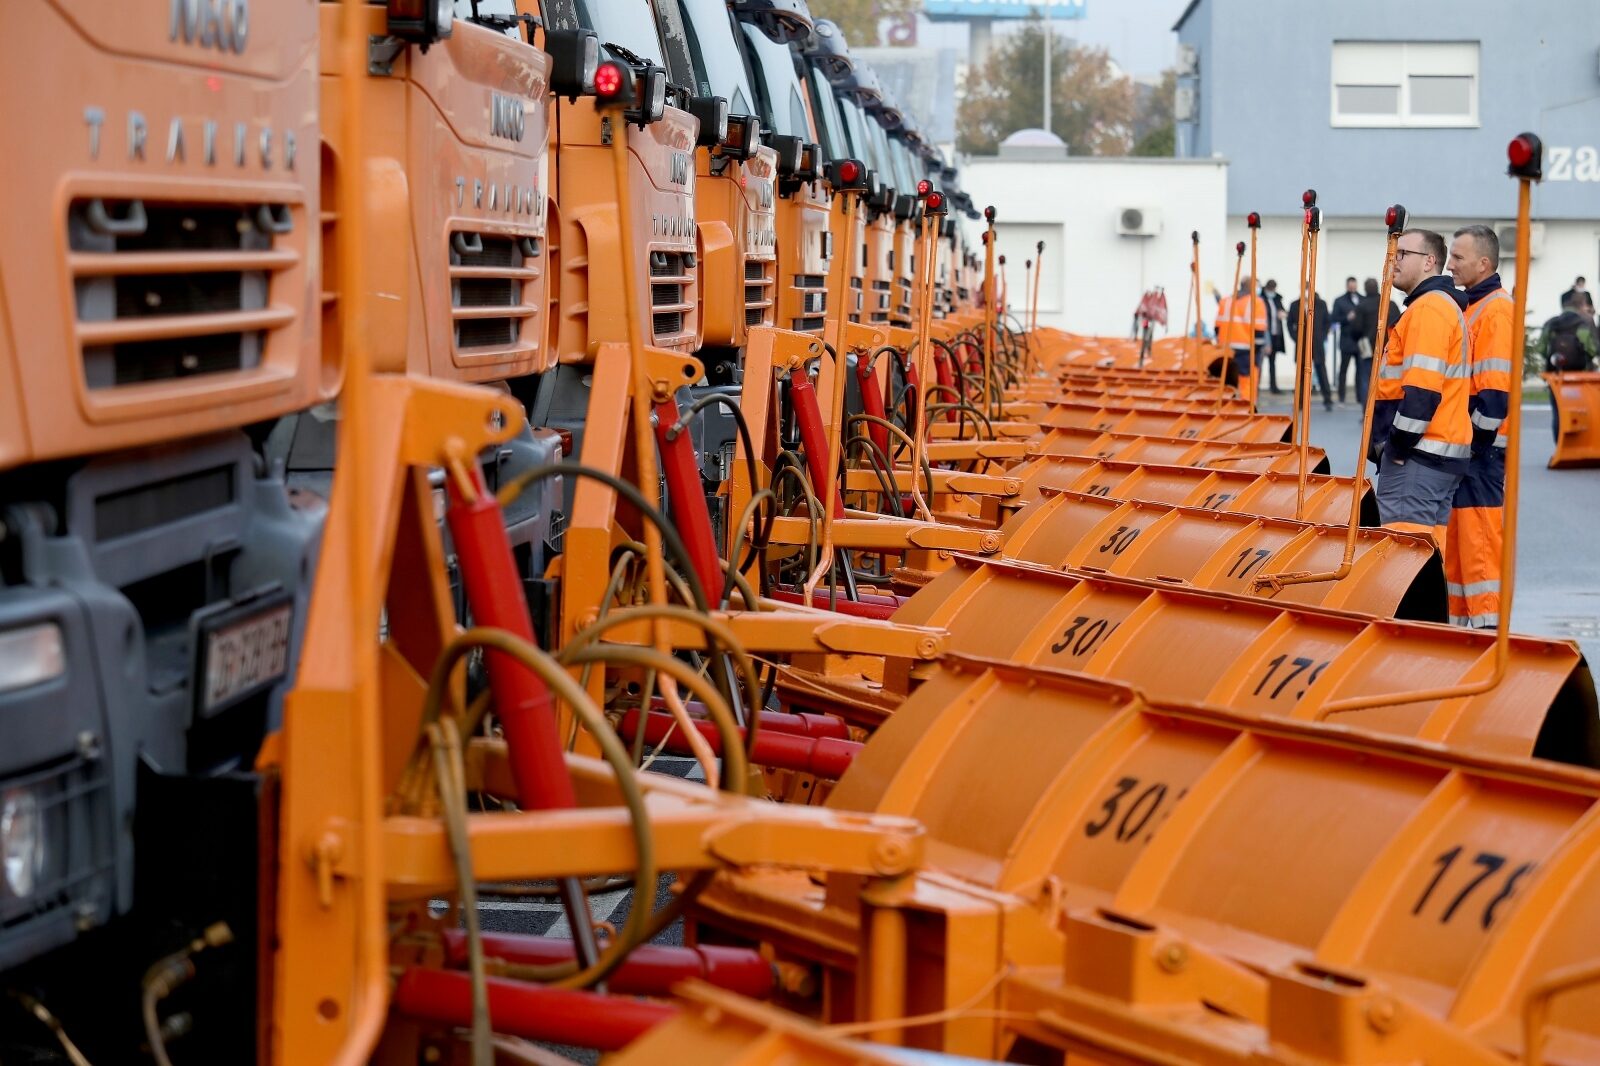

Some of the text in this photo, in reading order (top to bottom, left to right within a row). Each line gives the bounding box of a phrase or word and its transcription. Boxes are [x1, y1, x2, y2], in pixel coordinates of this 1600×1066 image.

[1100, 526, 1141, 556] 30
[1227, 547, 1273, 579] 17
[1050, 616, 1121, 657] 30
[1085, 777, 1188, 844] 30
